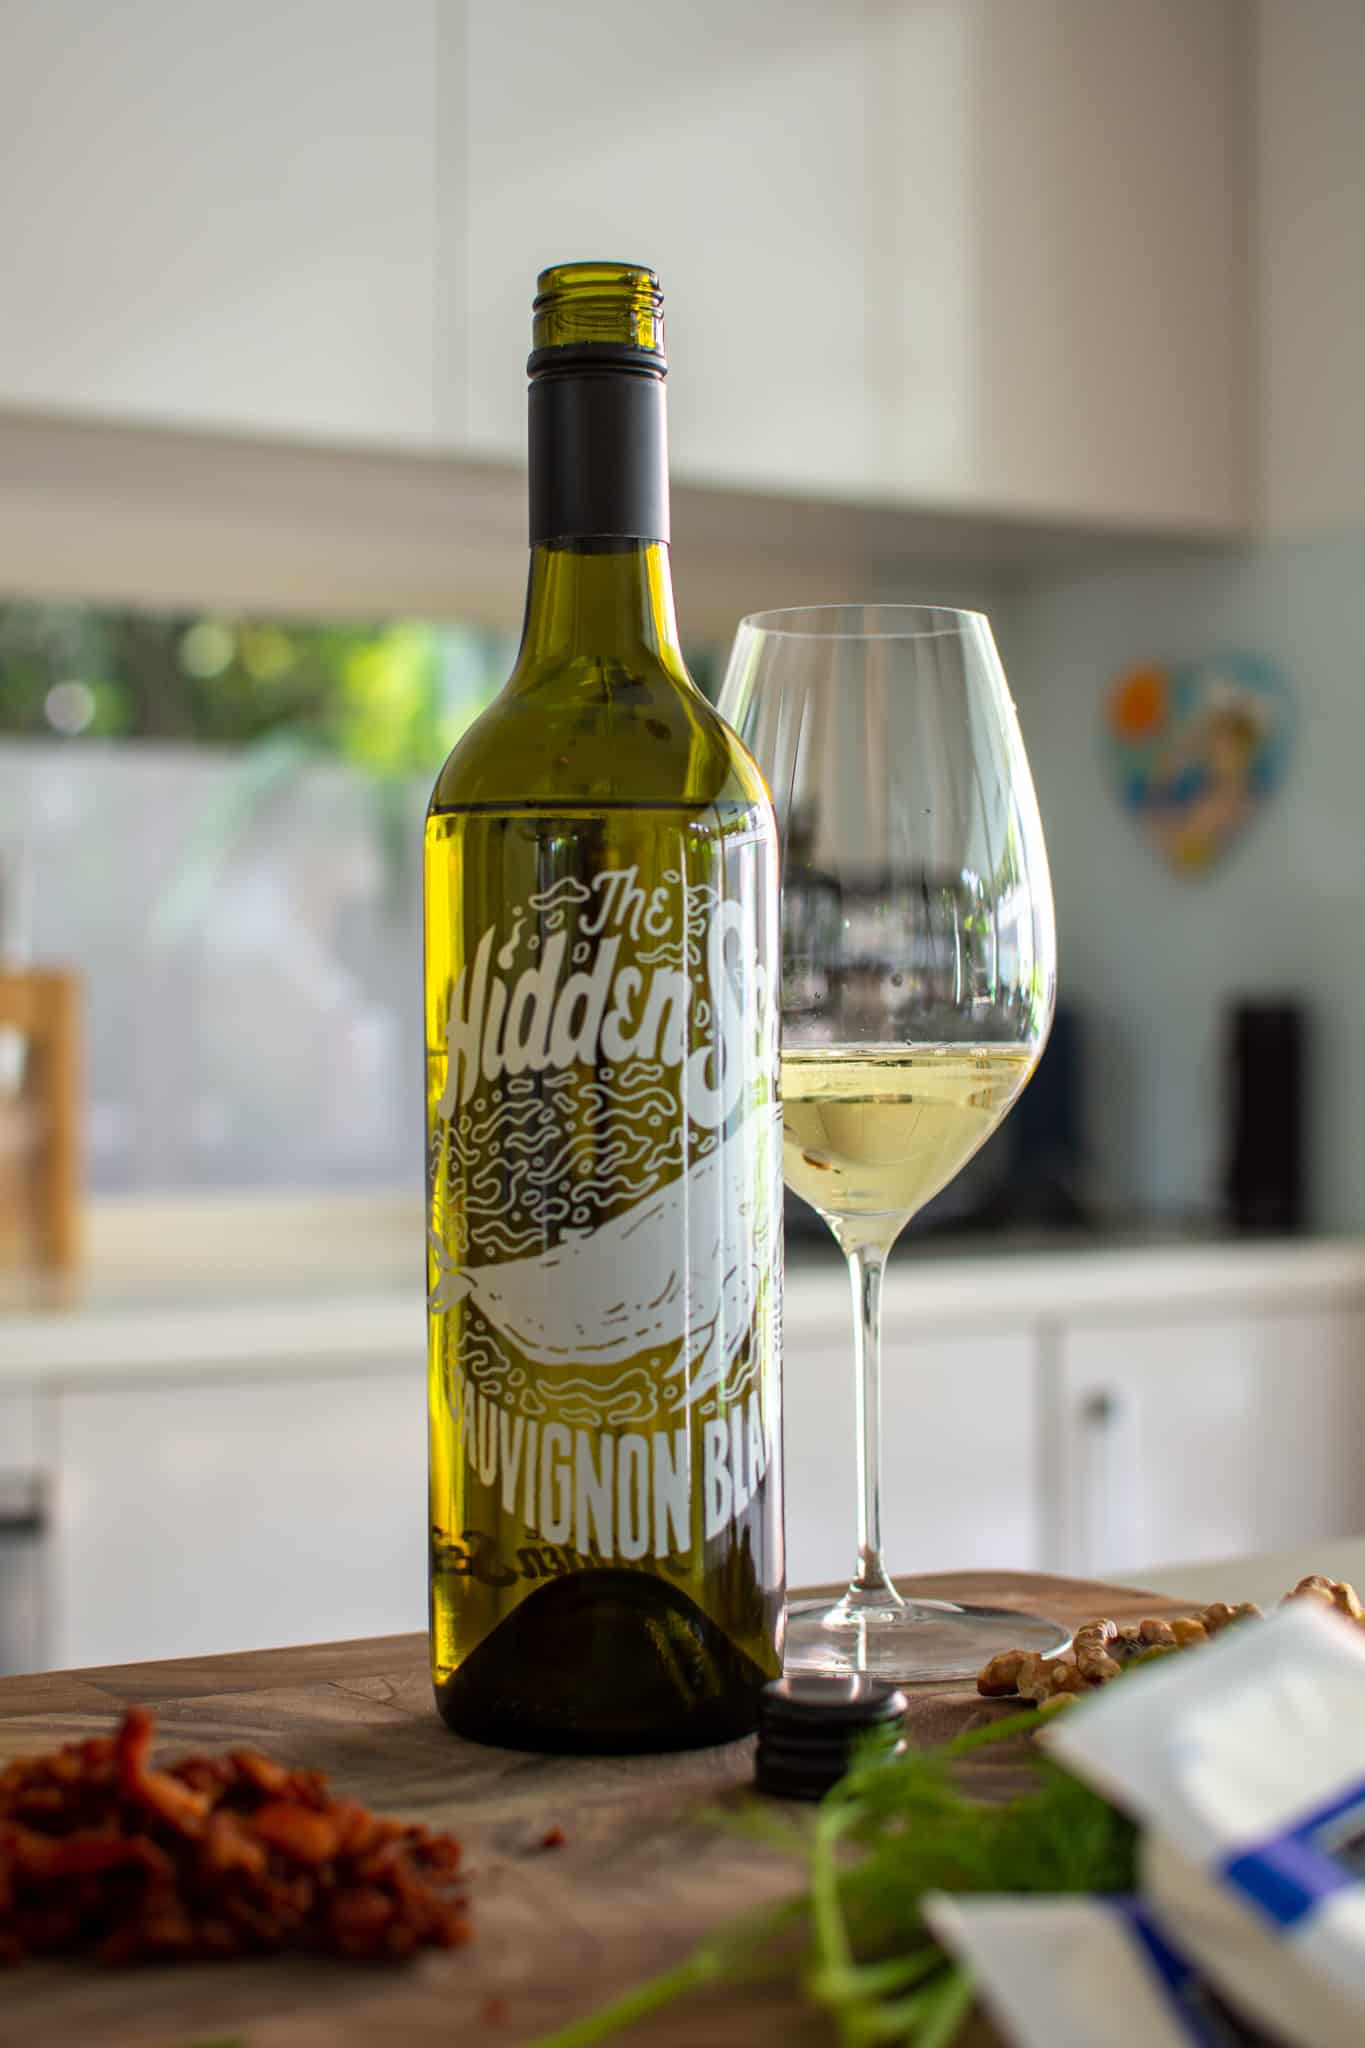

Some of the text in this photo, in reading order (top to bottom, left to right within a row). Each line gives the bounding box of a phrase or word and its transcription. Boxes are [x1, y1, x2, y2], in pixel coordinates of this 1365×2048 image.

[579, 865, 673, 941] The
[438, 919, 694, 1121] Hidden
[703, 1390, 772, 1543] BLA
